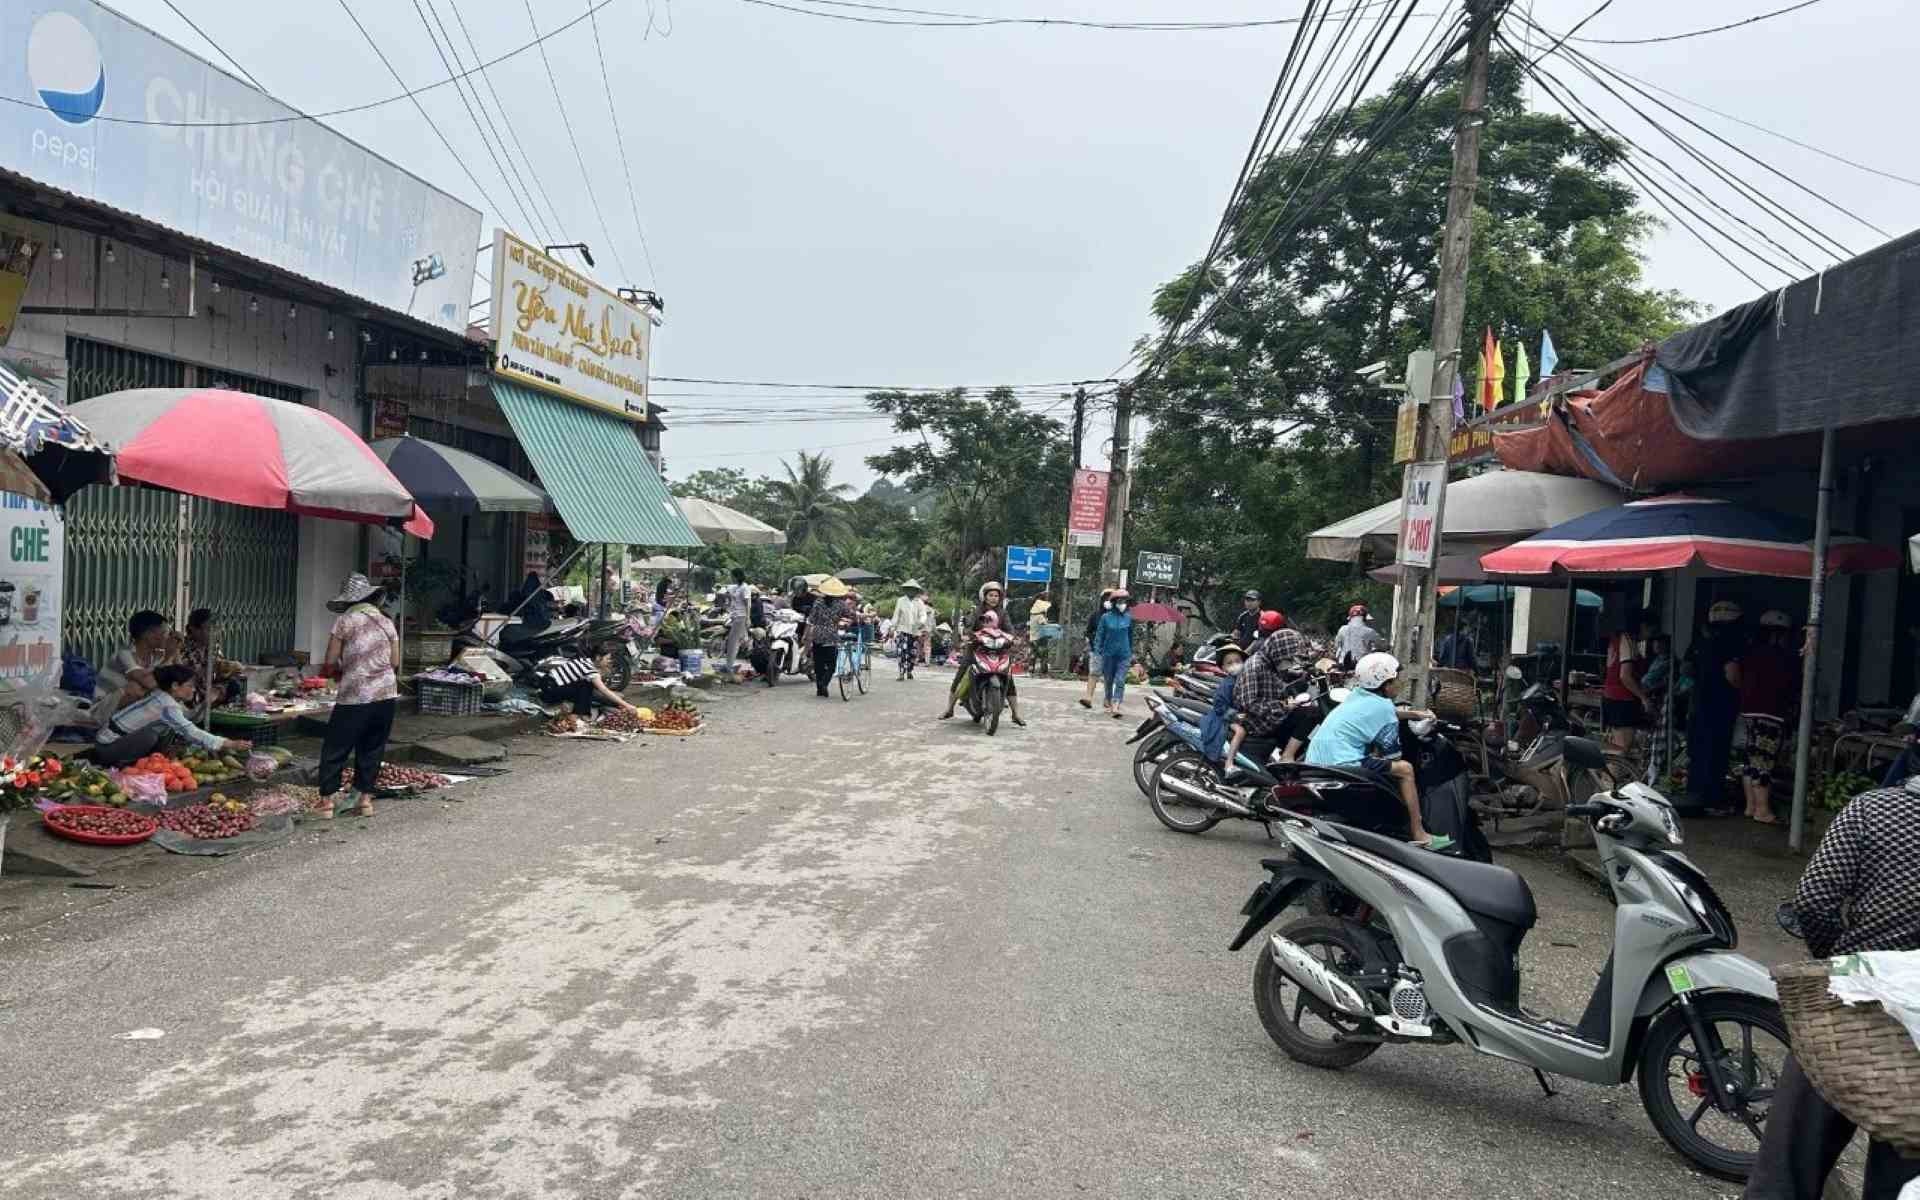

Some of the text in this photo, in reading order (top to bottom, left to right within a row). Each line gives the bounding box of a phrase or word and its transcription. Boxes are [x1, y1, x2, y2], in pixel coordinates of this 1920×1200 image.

[32, 128, 97, 171] pepsi
[144, 76, 304, 193] CHUNG
[10, 519, 49, 562] CHÈ
